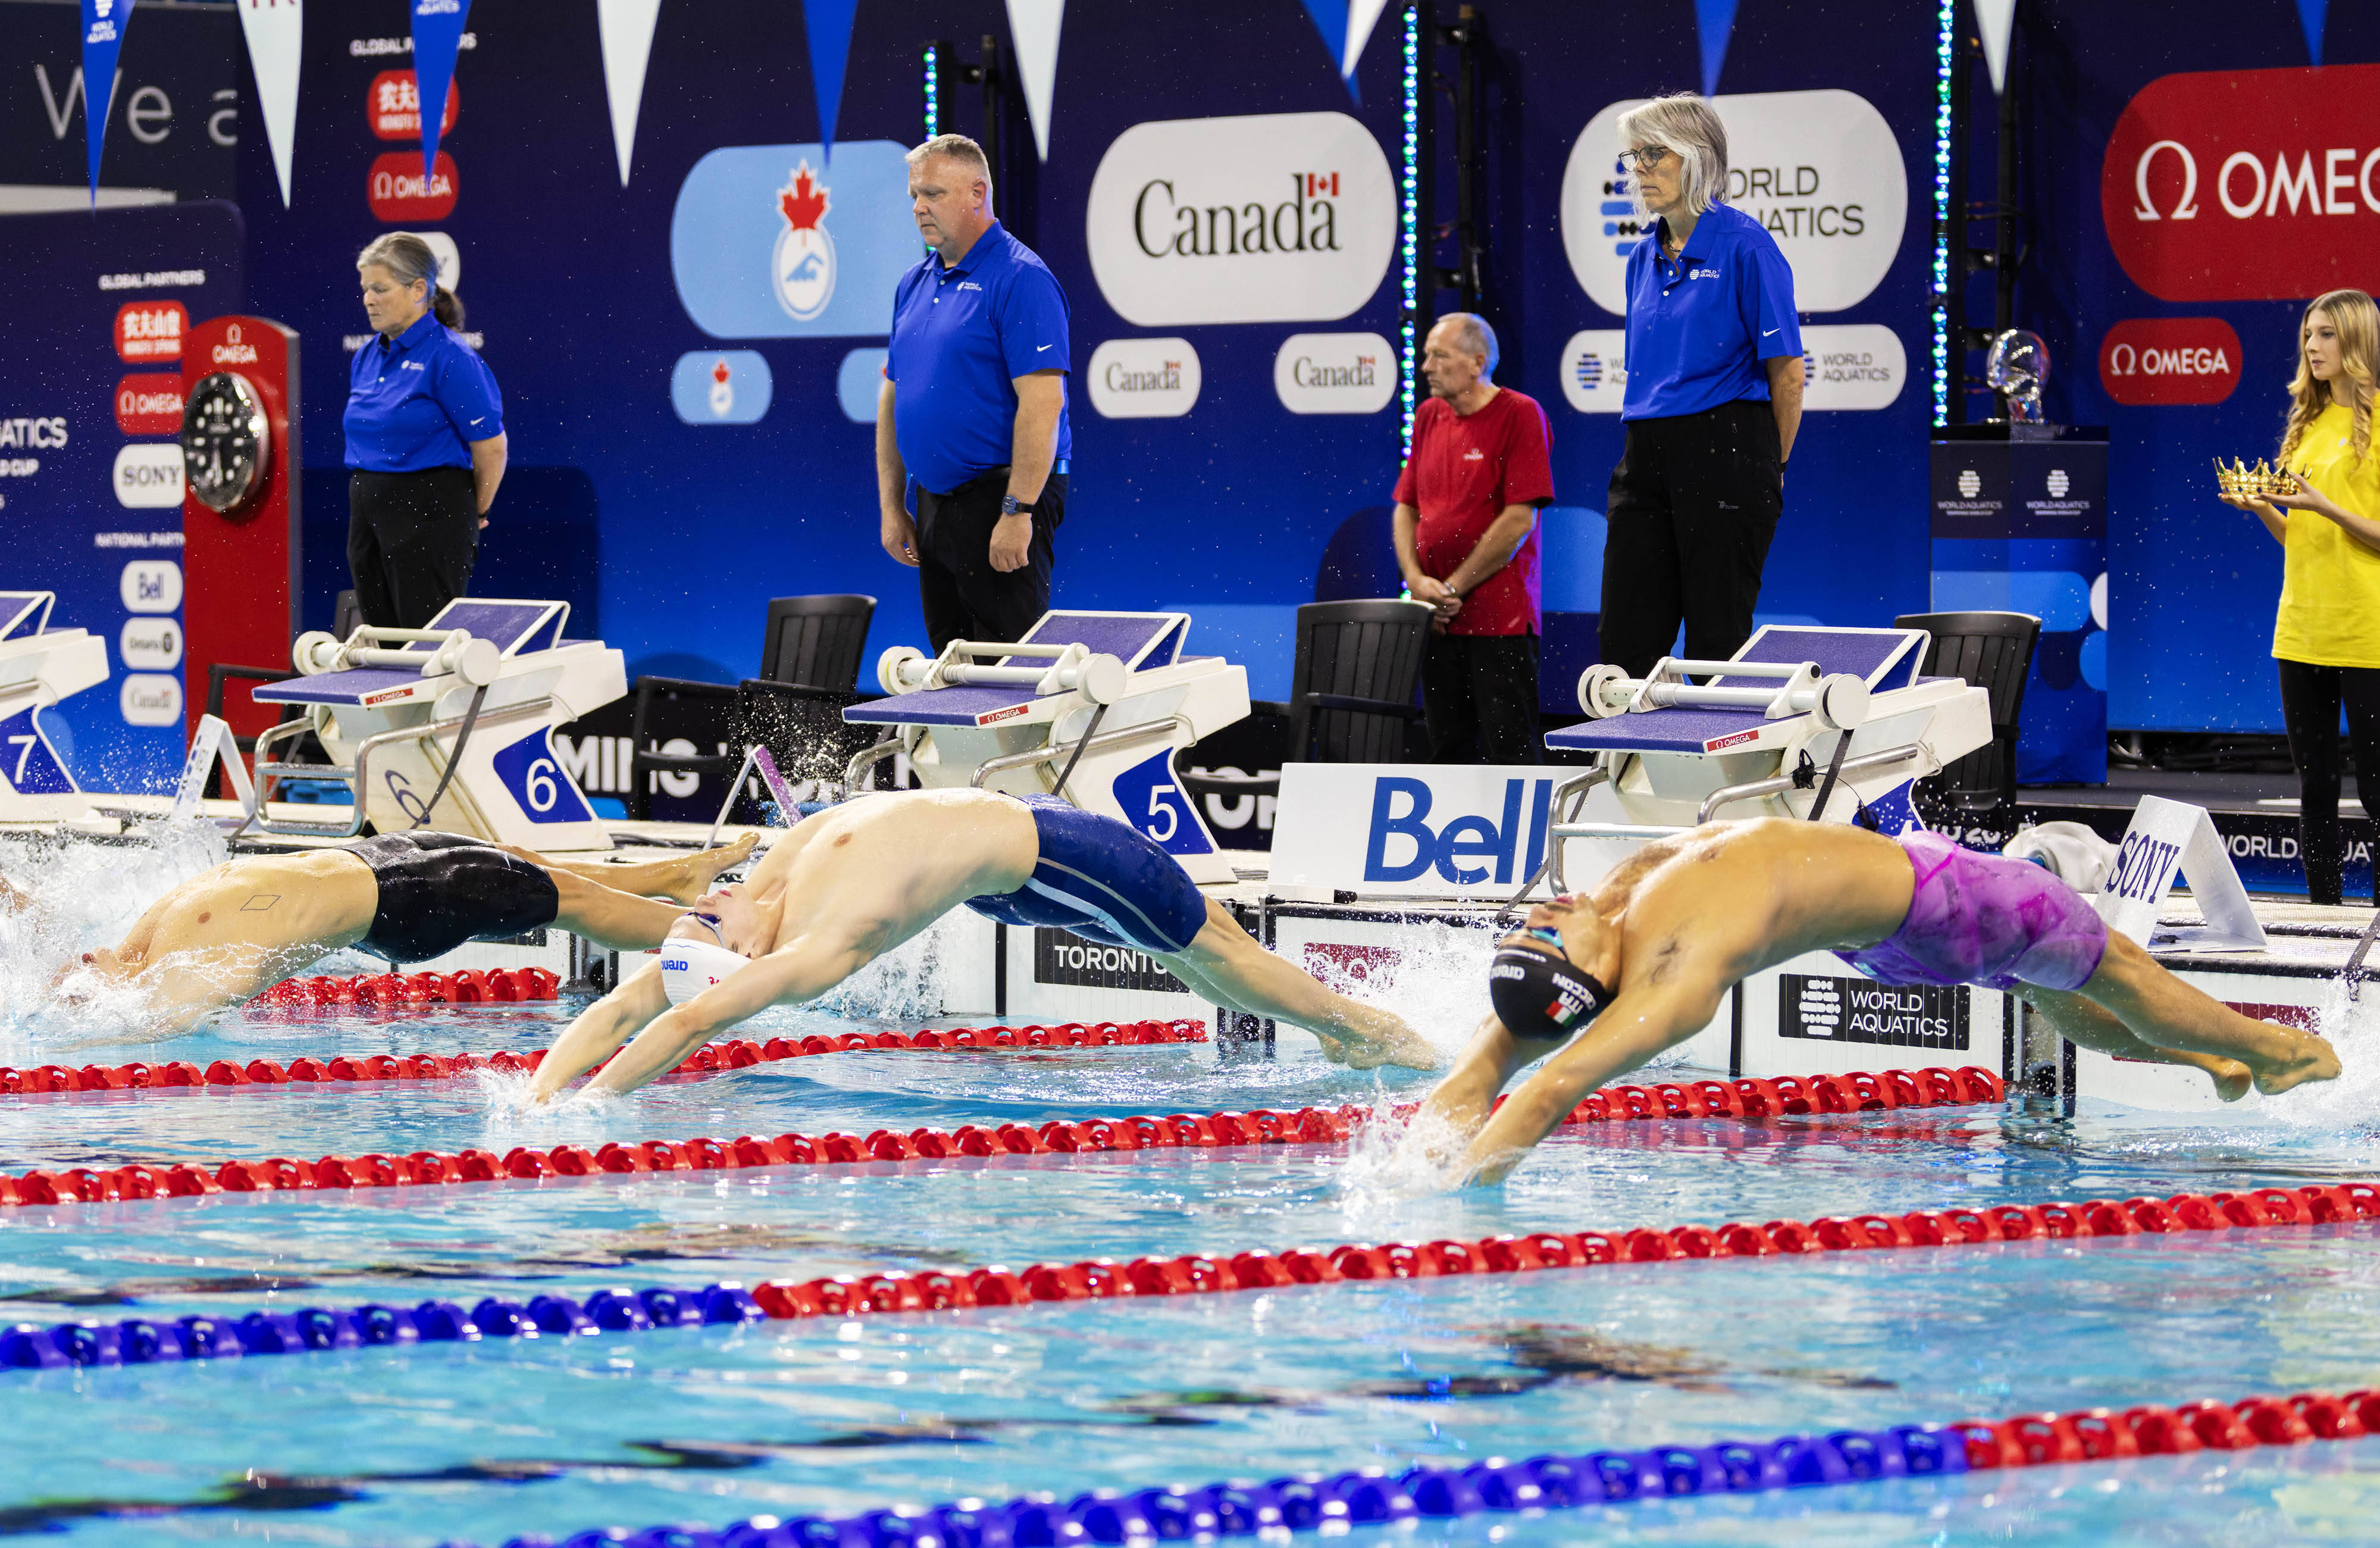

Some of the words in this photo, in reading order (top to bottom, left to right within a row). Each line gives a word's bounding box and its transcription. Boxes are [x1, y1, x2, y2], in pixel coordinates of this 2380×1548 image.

[393, 174, 452, 199] OMEGA
[1729, 166, 1820, 199] ORLD
[1134, 173, 1342, 258] Canada
[1759, 205, 1865, 237] ATICS
[212, 345, 258, 364] OMEGA
[1822, 352, 1873, 367] WORLD
[2142, 347, 2230, 376] OMEGA
[1105, 360, 1180, 392] Canada
[1294, 356, 1374, 388] Canada
[1822, 367, 1890, 382] AQUATICS
[136, 393, 184, 415] OMEGA
[121, 464, 183, 488] SONY
[138, 572, 164, 600] Bell
[381, 690, 406, 701] OMEGA
[995, 708, 1020, 720] OMEGA
[1724, 734, 1750, 746] OMEGA
[8, 734, 37, 784] 7
[385, 769, 431, 824] 6
[526, 758, 558, 812] 6
[1147, 784, 1178, 842] 5
[1363, 776, 1554, 885] Bell
[2104, 830, 2181, 904] SONY
[1558, 990, 1584, 1015] ITA
[1850, 990, 1923, 1012] WORLD
[1849, 1013, 1949, 1037] AQUATICS
